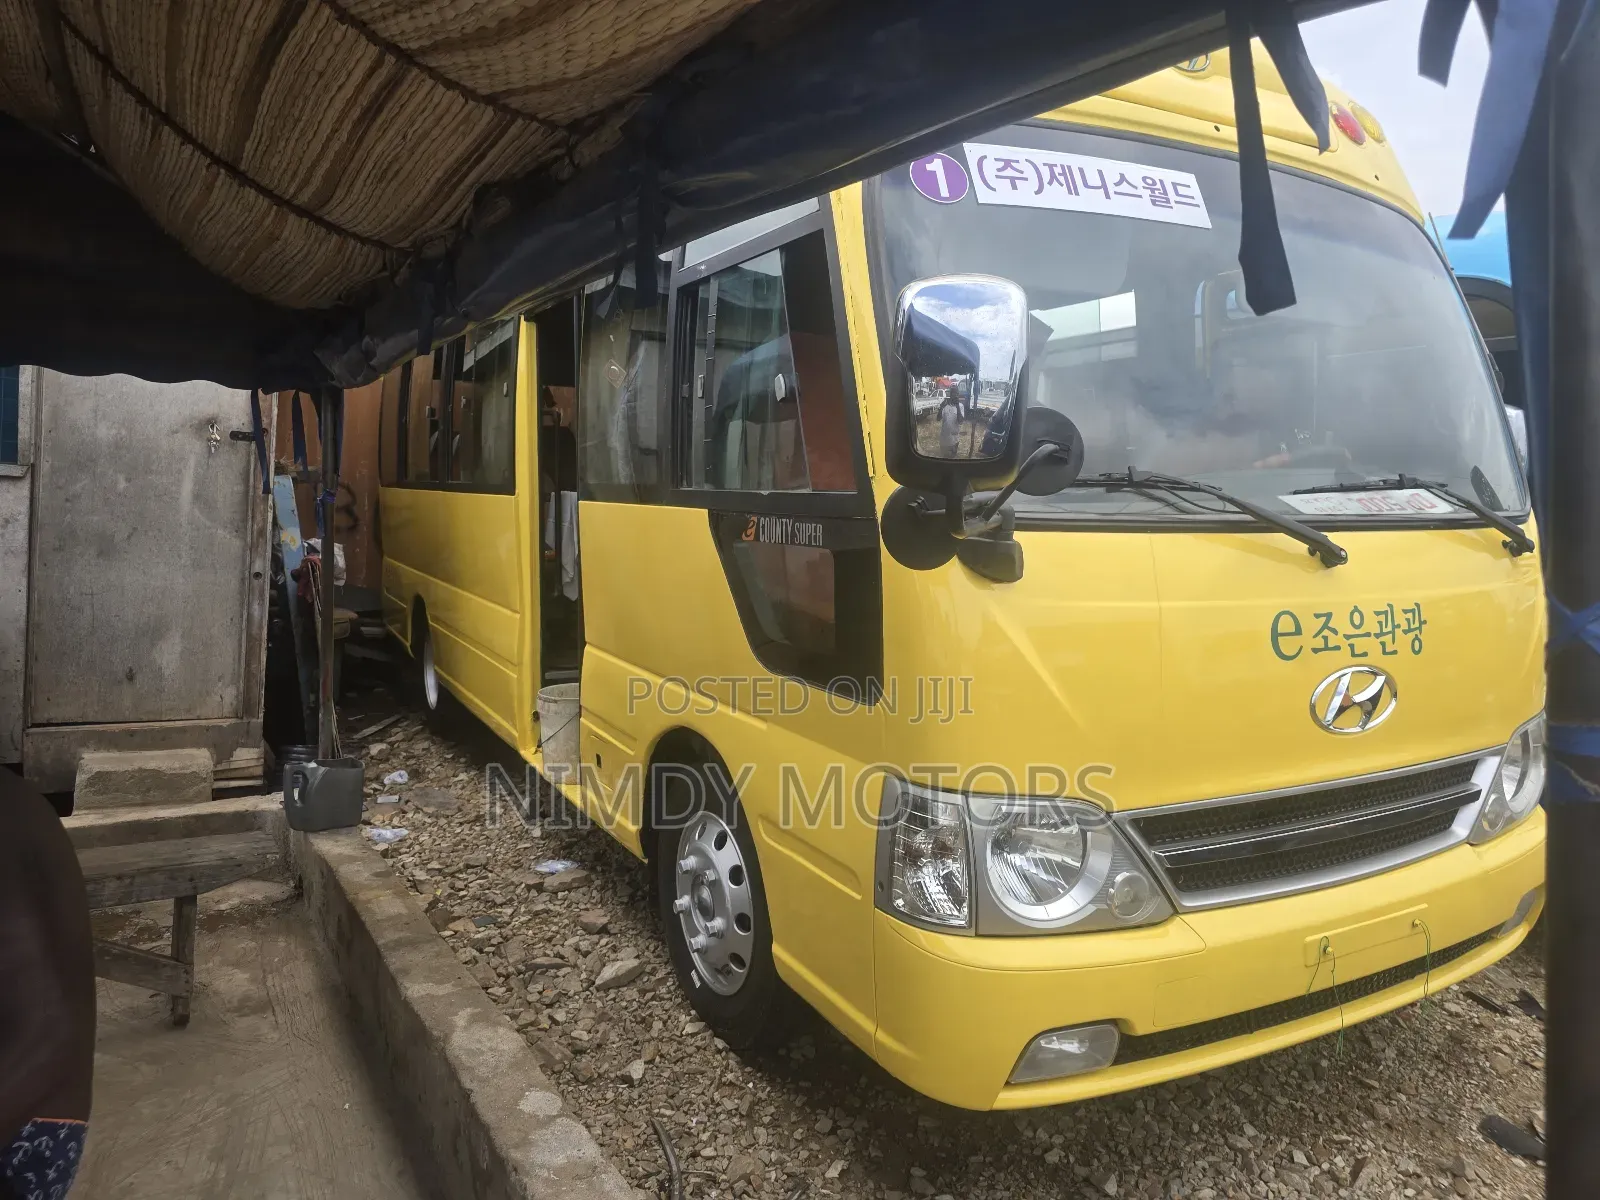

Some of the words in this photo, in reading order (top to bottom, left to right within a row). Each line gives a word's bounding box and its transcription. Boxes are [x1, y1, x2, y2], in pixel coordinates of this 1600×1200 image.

[925, 158, 950, 198] 1
[976, 154, 1201, 210] (주)제니스월드
[760, 516, 793, 545] COUNTY
[794, 521, 823, 546] SUPER
